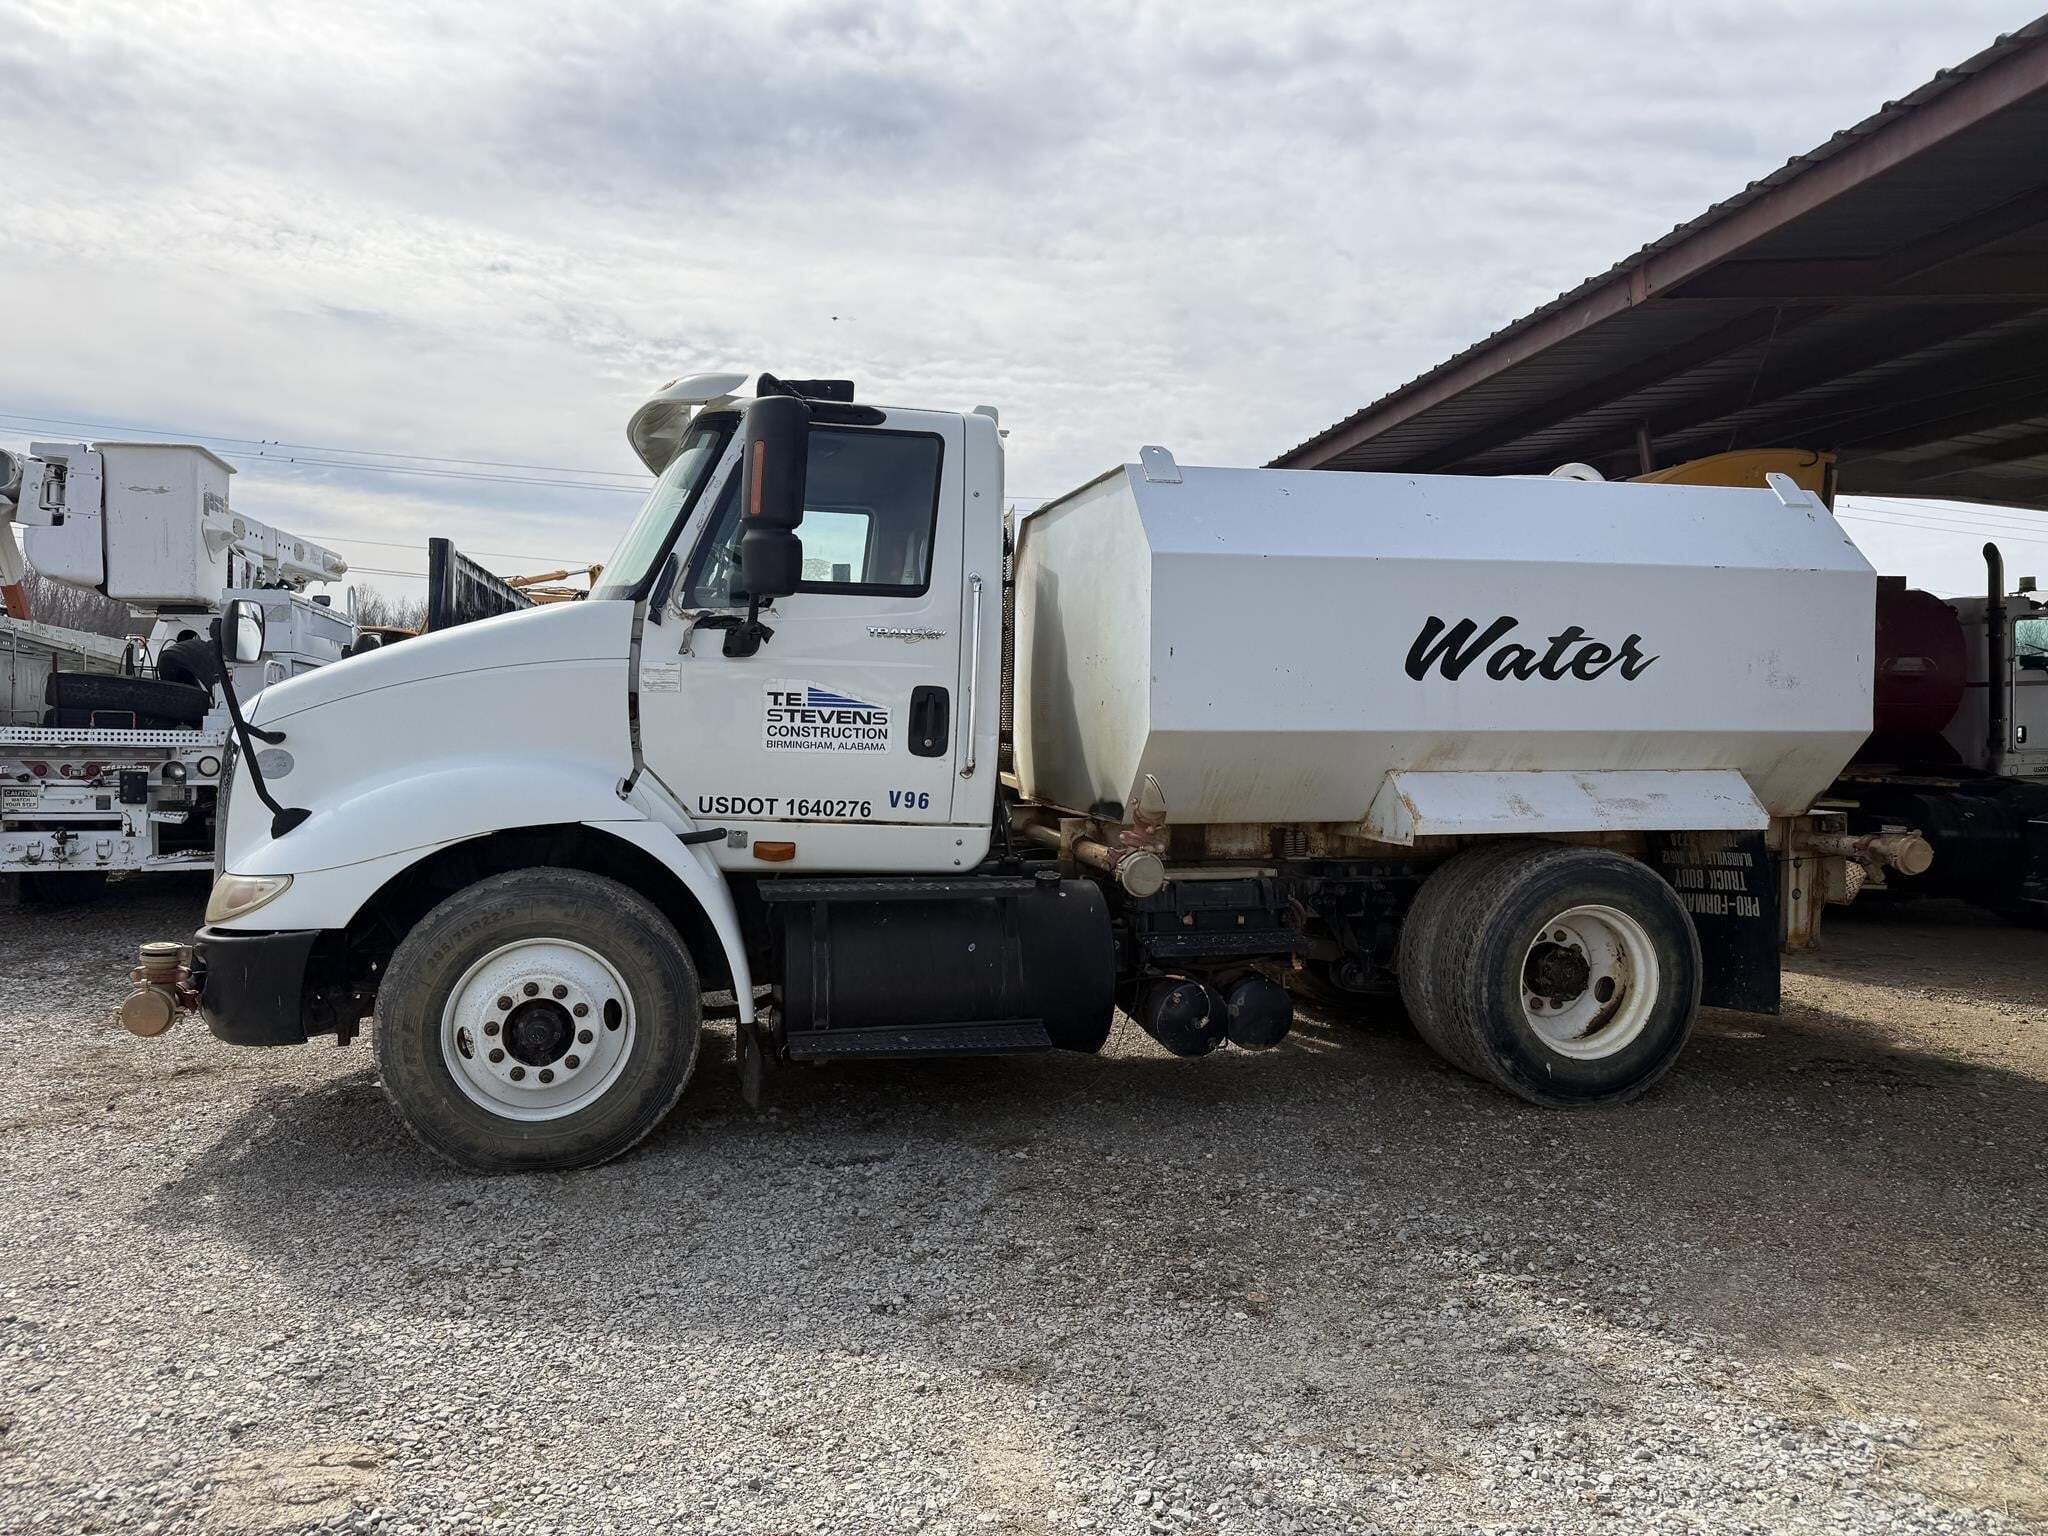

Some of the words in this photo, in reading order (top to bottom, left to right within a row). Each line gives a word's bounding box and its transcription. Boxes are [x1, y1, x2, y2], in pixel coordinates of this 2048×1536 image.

[1404, 615, 1661, 681] Water
[766, 691, 806, 707] T.E.
[767, 708, 888, 725] STEVENS
[767, 725, 888, 739] CONSTRUCTION
[766, 740, 835, 750] BIRMINGHAM,
[838, 742, 886, 751] ALABAMA
[698, 796, 779, 816] USDOT
[786, 799, 872, 817] 1640276
[889, 790, 930, 810] V96
[1674, 868, 1704, 888] BODY
[1709, 869, 1748, 891] TRUCK
